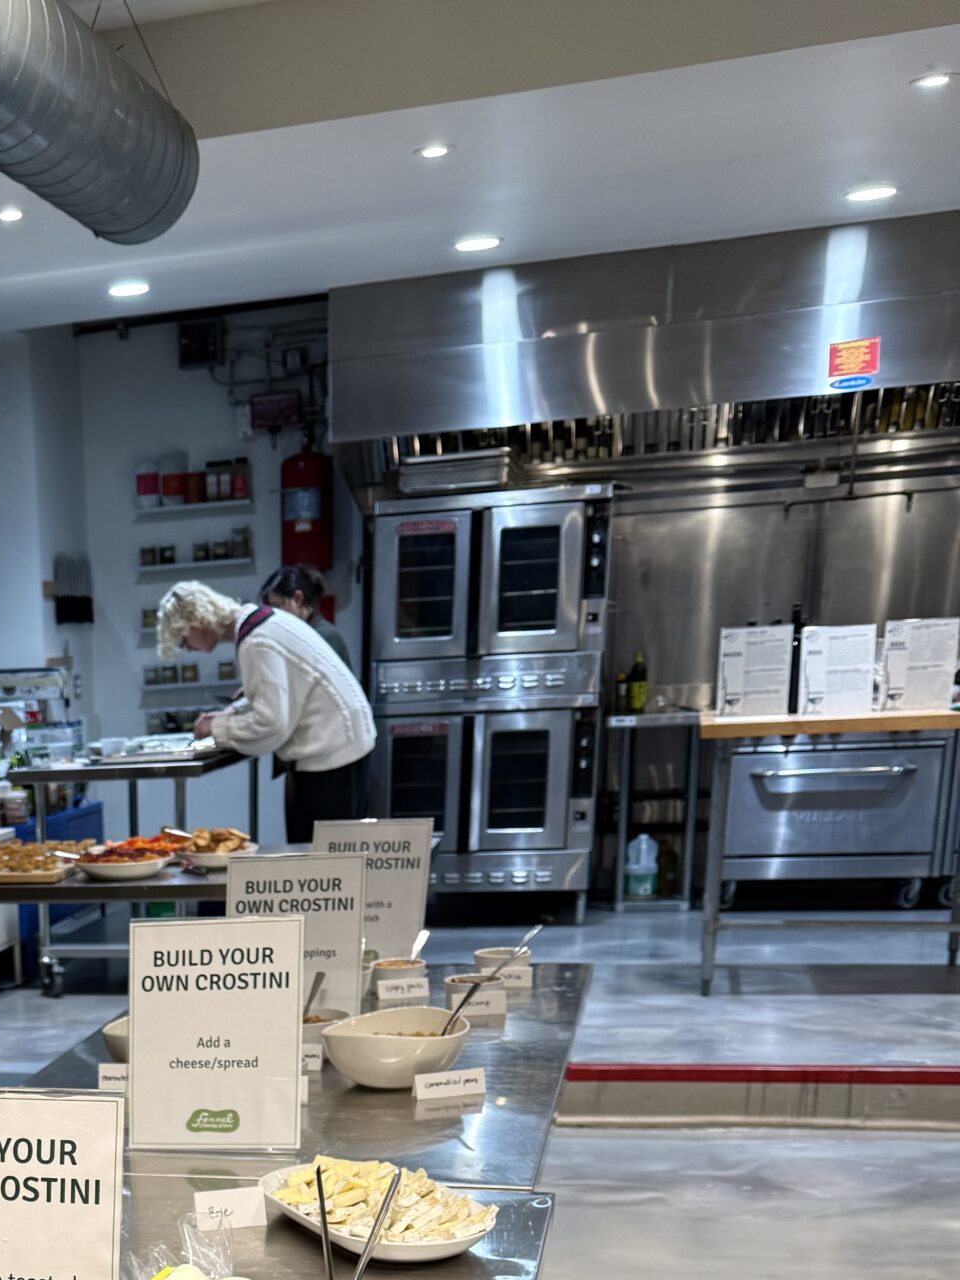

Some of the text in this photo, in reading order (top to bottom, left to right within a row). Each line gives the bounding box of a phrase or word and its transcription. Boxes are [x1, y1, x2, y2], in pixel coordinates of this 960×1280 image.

[328, 841, 411, 853] BUILD YOUR
[366, 857, 421, 869] ROSTINI
[245, 878, 342, 894] BUILD YOUR
[235, 897, 354, 914] OWN CROSTINI
[153, 947, 274, 968] BUILD YOUR
[141, 971, 290, 993] OWN CROSTINI
[196, 1036, 231, 1049] Add a
[169, 1056, 259, 1071] cheese/spread
